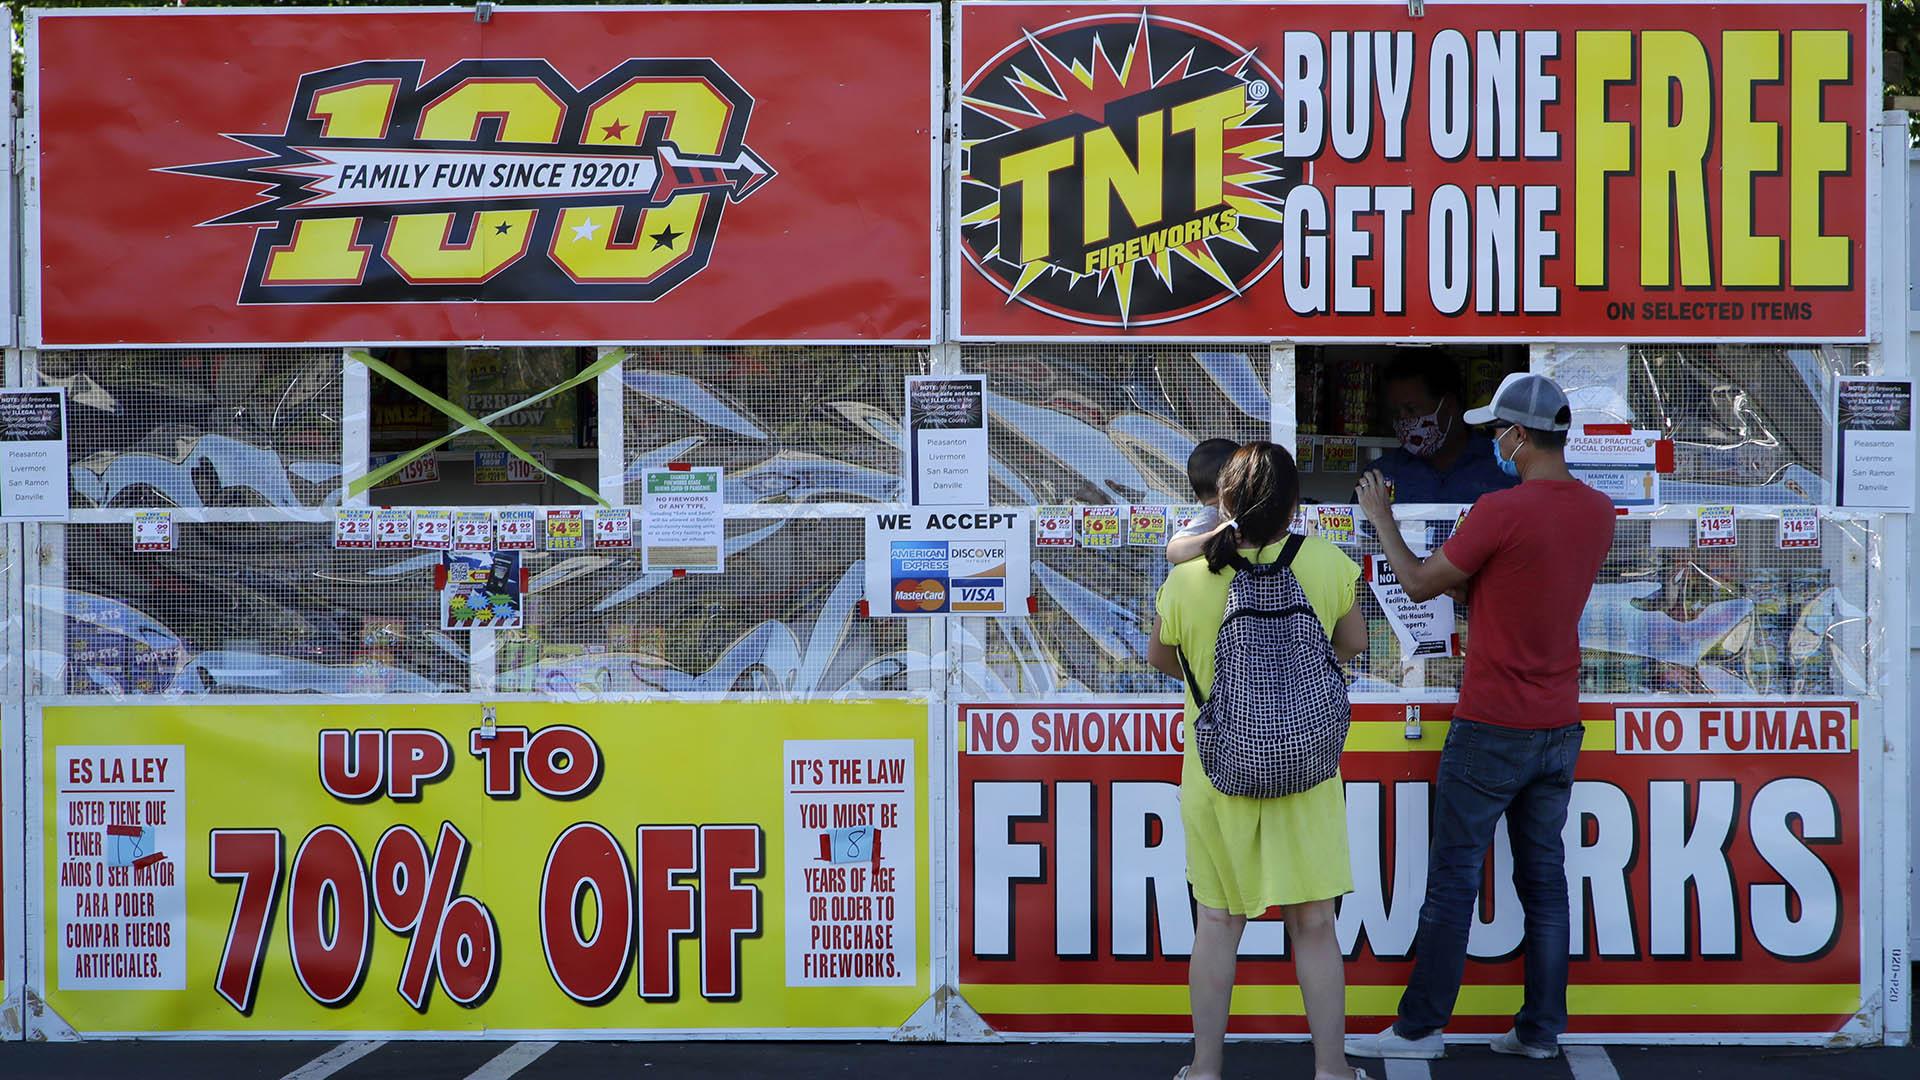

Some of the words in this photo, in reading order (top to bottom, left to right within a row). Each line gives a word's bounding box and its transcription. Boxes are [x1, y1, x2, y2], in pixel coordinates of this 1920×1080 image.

[1283, 30, 1415, 160] BUY
[1428, 29, 1560, 160] ONE
[1000, 82, 1247, 263] TNT
[1575, 30, 1852, 289] FREE
[258, 75, 736, 287] 100
[339, 165, 429, 189] FAMILY
[433, 164, 481, 188] FUN
[489, 165, 563, 188] SINCE
[570, 164, 640, 188] 1920!
[1084, 207, 1238, 274] FIREWORKS
[1283, 184, 1413, 315] GET
[1428, 184, 1560, 315] ONE
[1606, 303, 1636, 321] ON
[1641, 303, 1745, 321] SELECTED
[1750, 303, 1813, 321] ITEMS
[9, 450, 48, 458] Pleasanton
[1854, 440, 1895, 448] Pleasanton
[500, 511, 533, 519] ORCHID
[877, 514, 912, 529] WE
[926, 513, 1017, 529] ACCEPT
[891, 549, 945, 558] AMERICAN
[903, 561, 949, 570] EXPRESS
[951, 549, 1004, 558] DISCOVER
[895, 591, 945, 600] MasterCard
[962, 588, 995, 601] VISA
[1404, 622, 1427, 630] operty.
[972, 712, 1019, 753] NO
[1031, 712, 1184, 753] SMOKING
[1624, 710, 1683, 751] NO
[1699, 710, 1846, 751] FUMAR
[69, 758, 93, 784] ES
[100, 758, 125, 783] LA
[132, 758, 169, 783] LEY
[319, 728, 452, 802] UP
[469, 725, 604, 801] TO
[790, 759, 823, 786] IT'S
[830, 759, 861, 785] THE
[867, 759, 906, 785] LAW
[68, 801, 105, 826] USTED
[110, 800, 141, 826] TIENE
[145, 800, 167, 826] QUE
[799, 803, 828, 829] YOU
[833, 803, 875, 829] MUST
[881, 803, 898, 829] BE
[67, 832, 102, 857] TENER
[61, 857, 92, 887] AÑOS
[96, 862, 103, 887] O
[108, 863, 129, 887] SER
[133, 861, 175, 887] MAYOR
[804, 868, 846, 894] YEARS
[850, 868, 867, 893] OF
[870, 867, 895, 893] AGE
[972, 777, 1844, 962] FIRWRKS
[76, 893, 109, 918] PARA
[115, 893, 154, 918] PODER
[208, 820, 499, 1014] 70%
[539, 821, 764, 1006] OFF
[809, 896, 827, 922] OR
[831, 896, 872, 921] OLDER
[875, 896, 895, 922] TO
[66, 923, 120, 948] COMPAR
[125, 923, 171, 948] FUEGOS
[811, 925, 893, 950] PURCHASE
[75, 953, 162, 979] ARTIFICIALES.
[804, 954, 901, 979] FIREWORKS.
